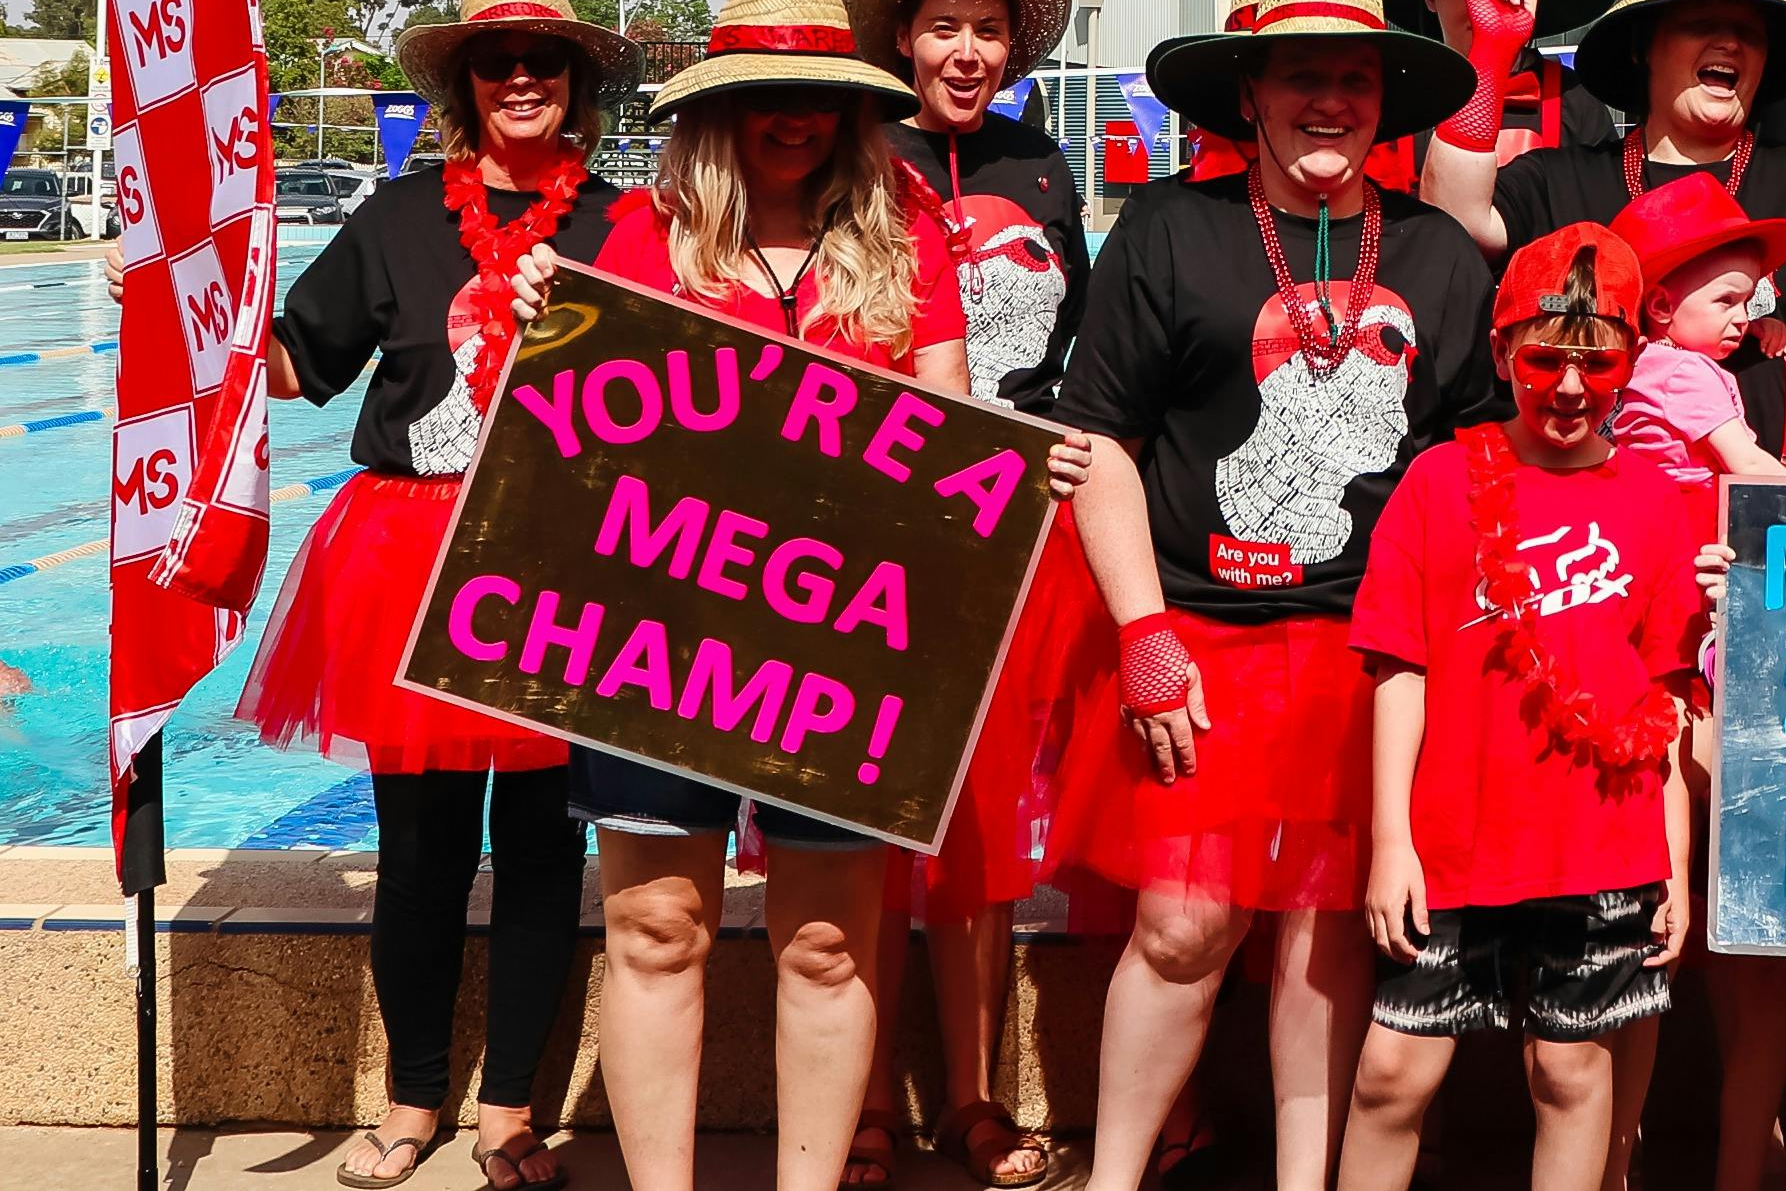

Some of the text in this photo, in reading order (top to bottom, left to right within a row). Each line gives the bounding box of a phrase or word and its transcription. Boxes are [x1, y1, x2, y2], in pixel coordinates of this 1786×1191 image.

[211, 106, 258, 185] MS
[187, 278, 229, 352] MS
[512, 344, 946, 484] YOU'RE
[933, 448, 1028, 539] A
[115, 448, 180, 516] MS
[594, 474, 909, 652] MEGA
[1216, 543, 1244, 562] Are
[1248, 551, 1280, 567] you
[1217, 566, 1293, 586] with me?
[447, 575, 905, 785] CHAMP!
